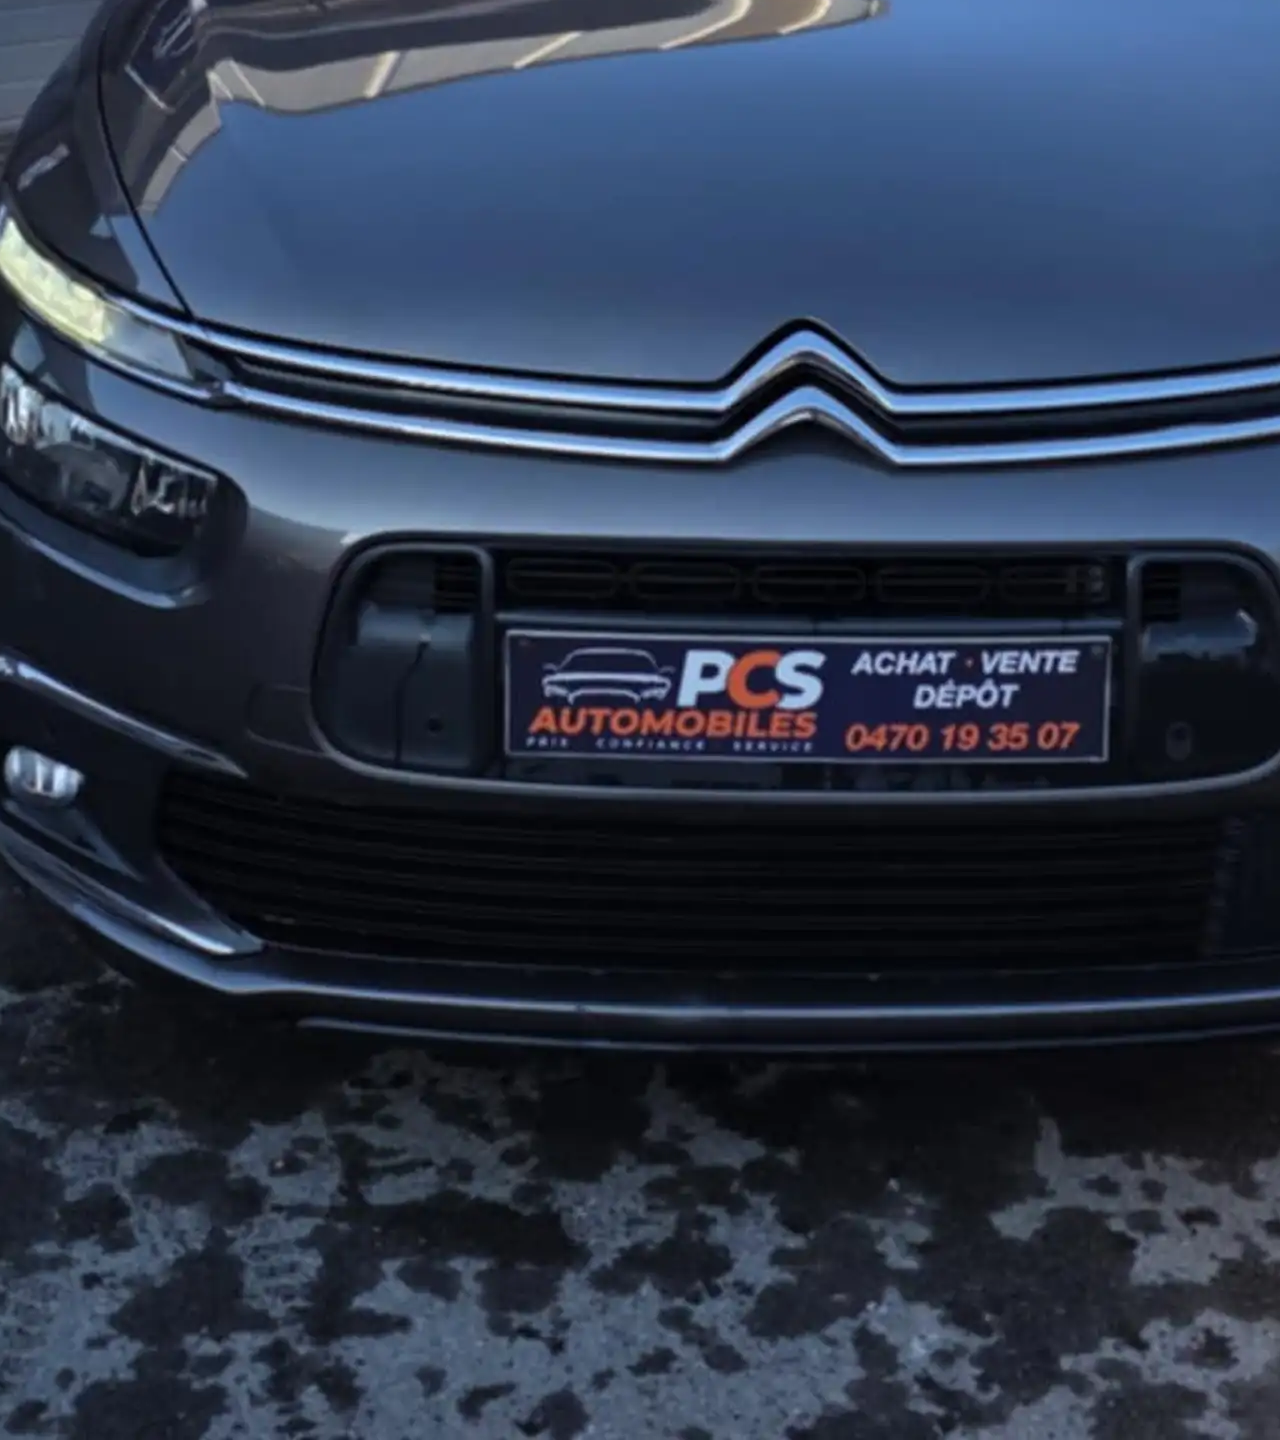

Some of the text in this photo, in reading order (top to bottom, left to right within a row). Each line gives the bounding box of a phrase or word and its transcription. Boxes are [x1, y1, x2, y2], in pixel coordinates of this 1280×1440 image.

[851, 650, 1080, 675] ACHAT VENTE
[677, 649, 826, 709] PCS
[913, 678, 1019, 709] DÉPÔT
[528, 706, 817, 739] AUTOMOBILES
[845, 721, 1081, 751] 0470 19 35 07
[525, 736, 813, 752] PRIX CONFIANCE SERVICE
